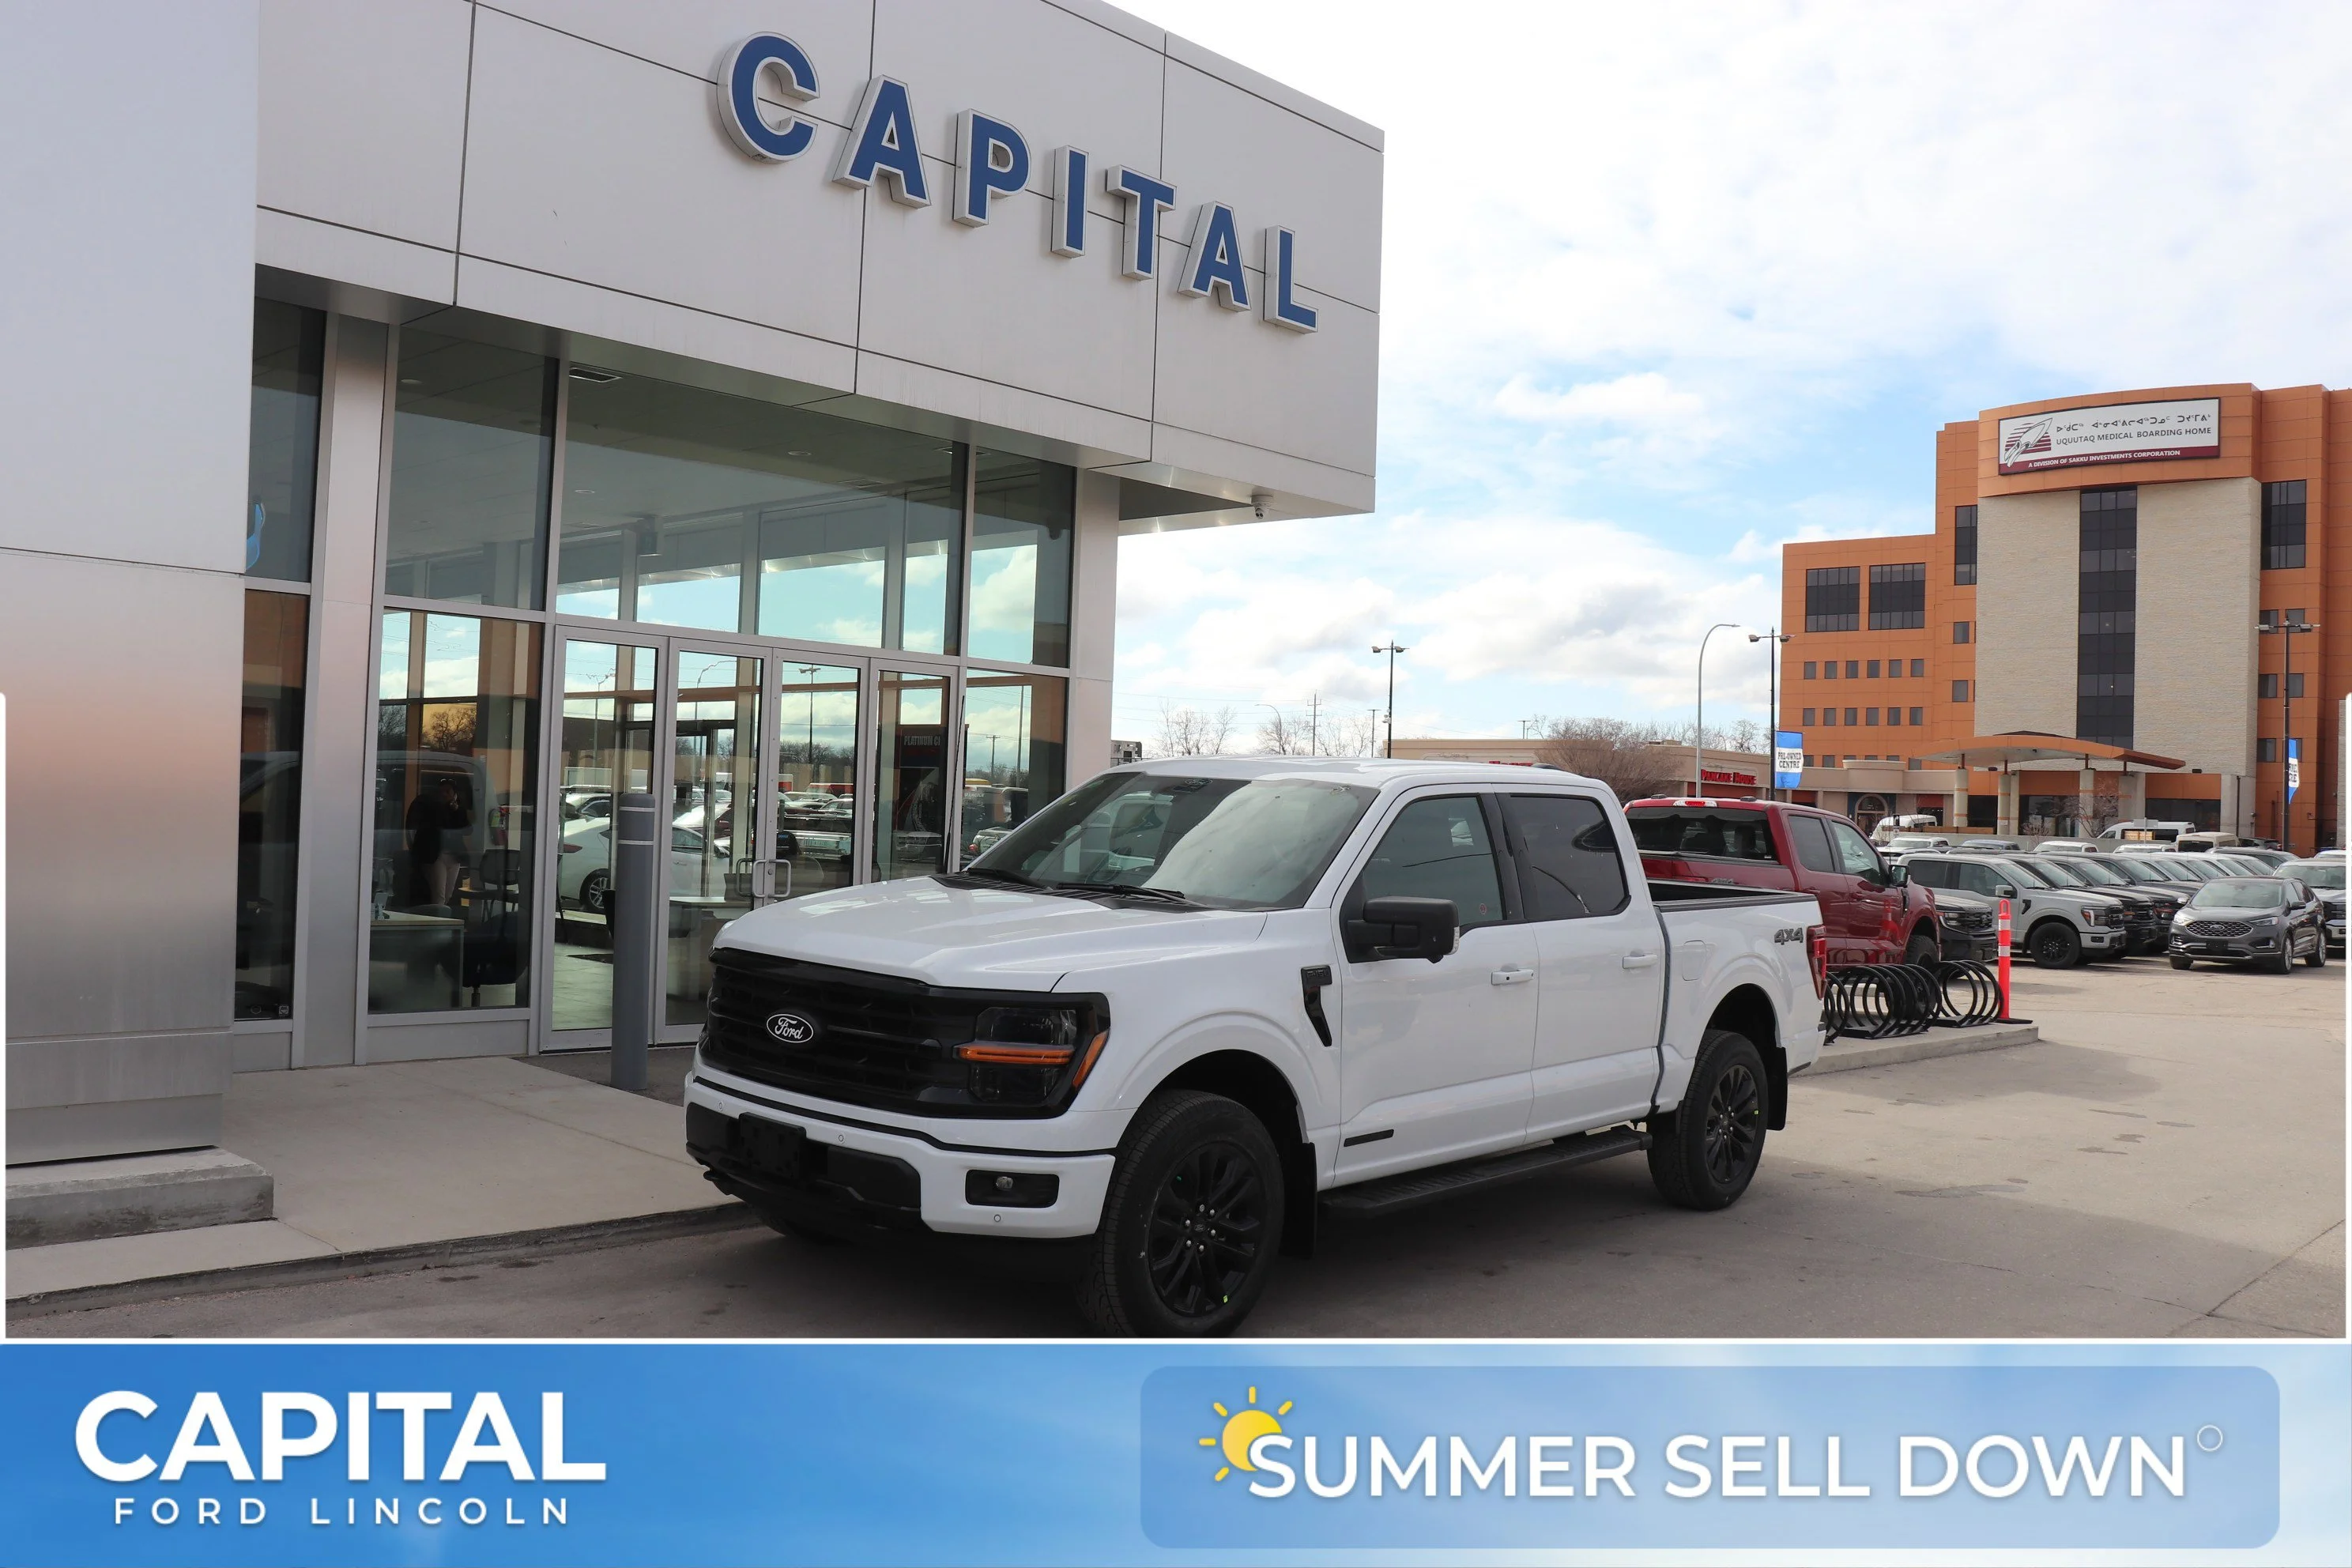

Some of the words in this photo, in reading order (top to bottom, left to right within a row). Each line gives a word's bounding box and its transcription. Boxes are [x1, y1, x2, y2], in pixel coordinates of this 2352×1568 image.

[716, 32, 1319, 334] CAPITAL
[2056, 435, 2095, 445] UQUUTAQ
[2098, 432, 2133, 441] MEDICAL
[2136, 428, 2182, 438] BOARDING
[2089, 452, 2132, 462] INVESTMENTS
[903, 736, 933, 746] PLATINUM
[1777, 752, 1802, 760] PRE-OWNED
[1779, 760, 1800, 769] CENTRE
[774, 1016, 805, 1040] Ford
